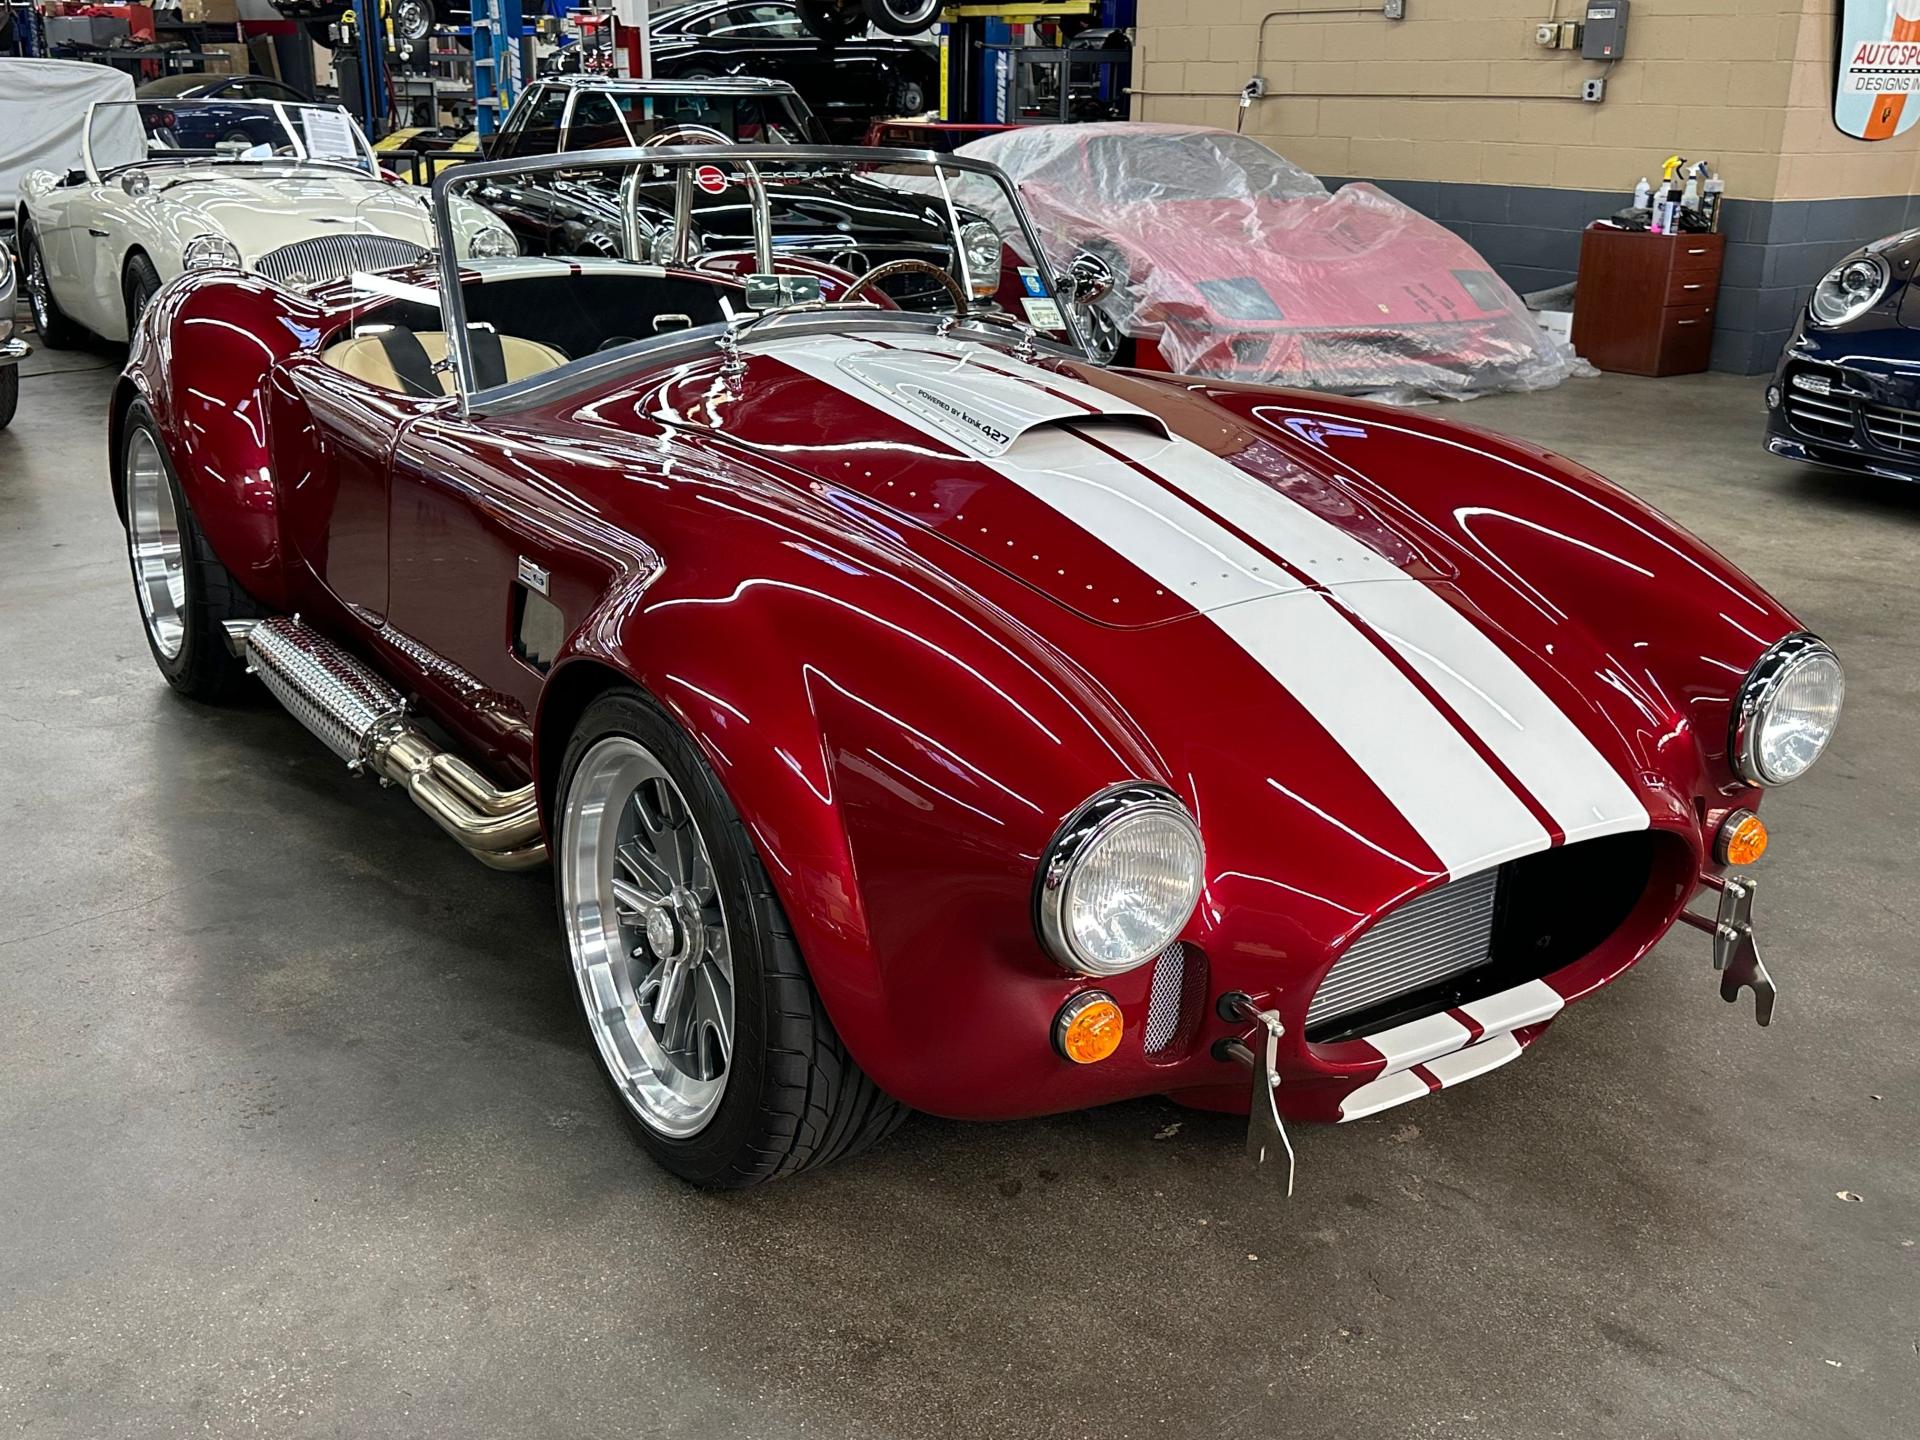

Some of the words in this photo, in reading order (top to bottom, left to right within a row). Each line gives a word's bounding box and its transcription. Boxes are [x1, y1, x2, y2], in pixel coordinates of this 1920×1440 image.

[1855, 77, 1910, 91] DESIGNS
[730, 171, 844, 179] BACKDRAFT
[918, 389, 950, 411] POWERED
[951, 407, 961, 417] BY
[982, 425, 1010, 445] 427
